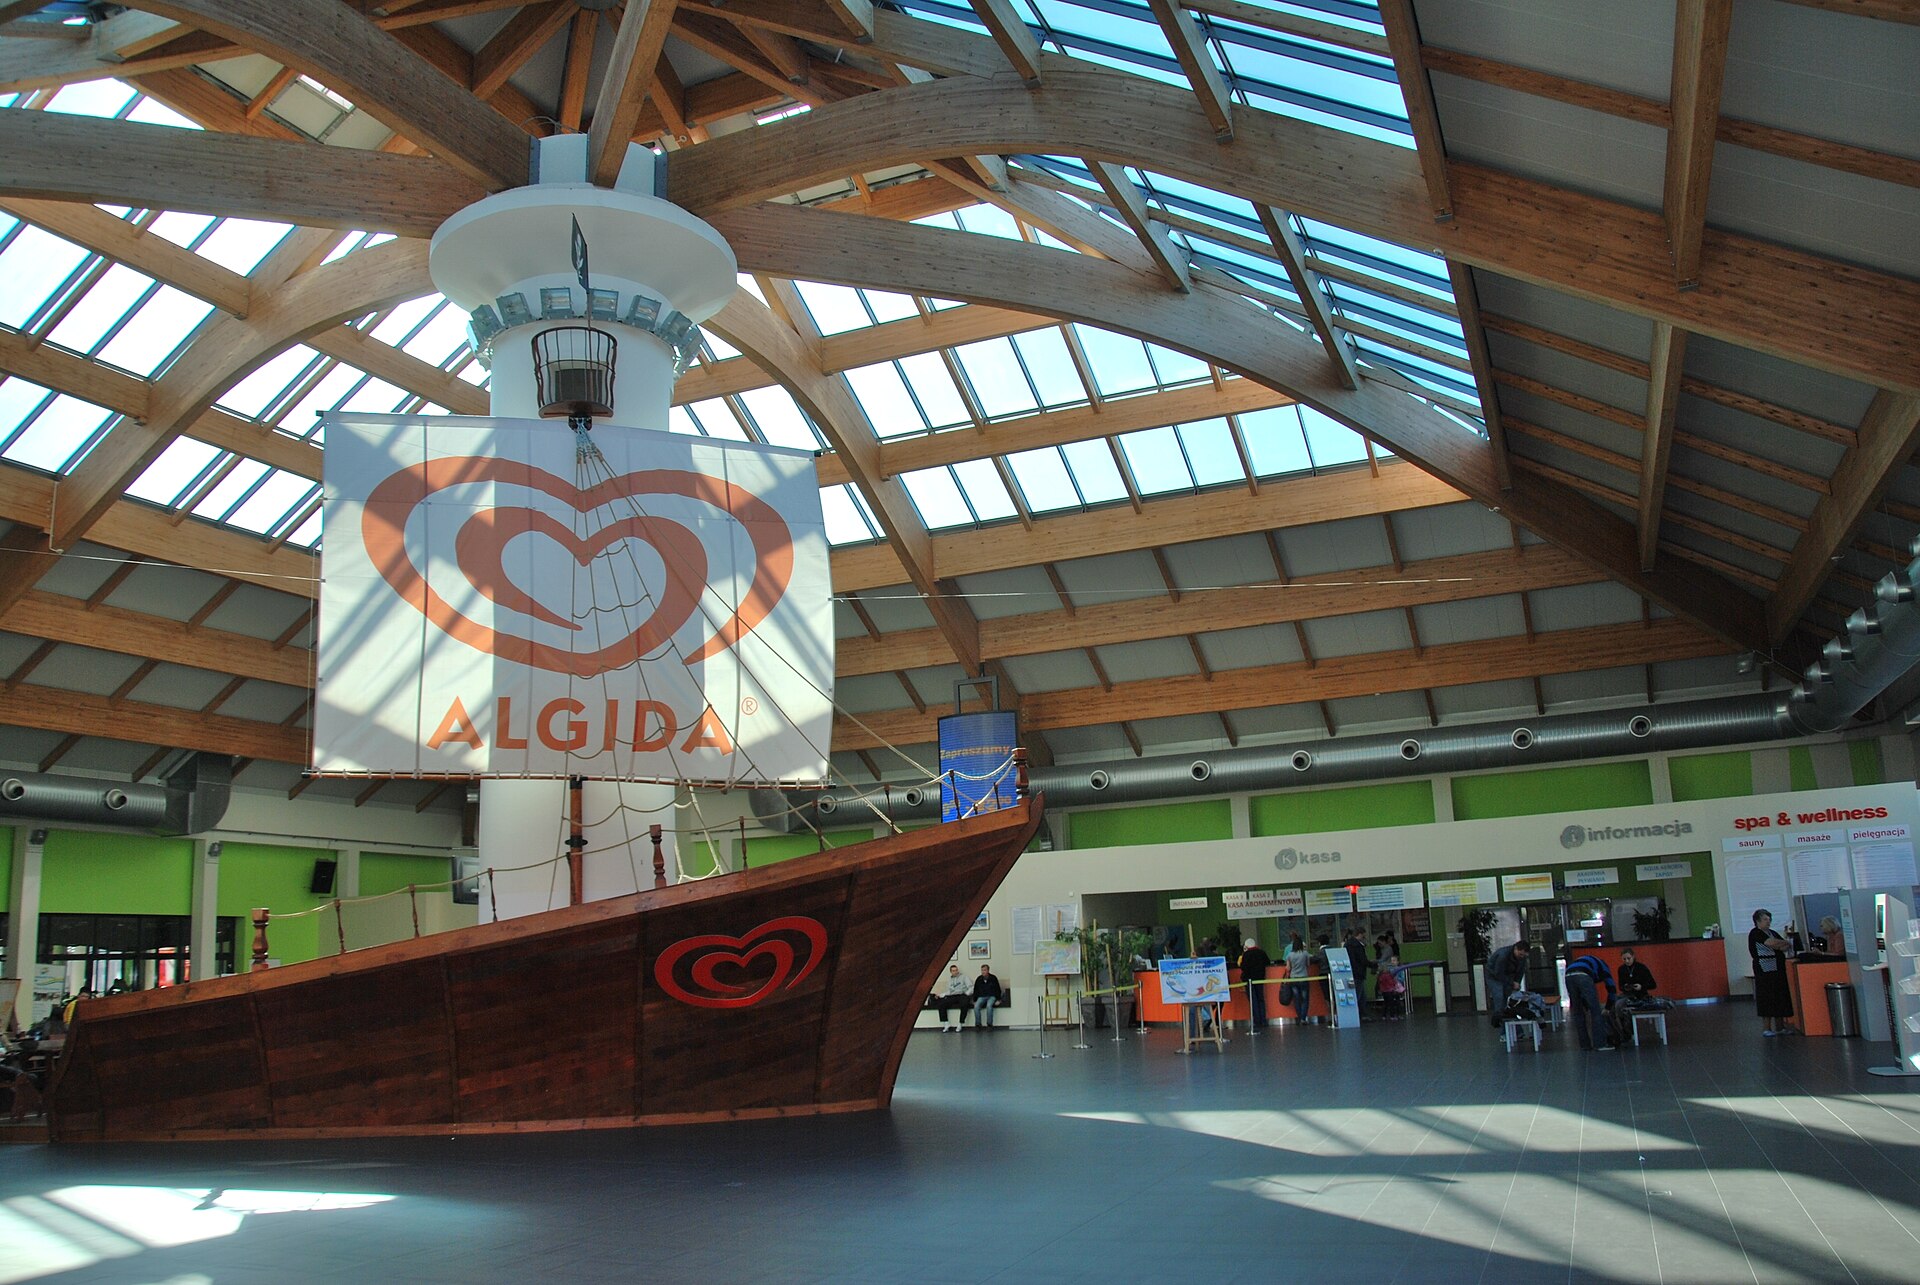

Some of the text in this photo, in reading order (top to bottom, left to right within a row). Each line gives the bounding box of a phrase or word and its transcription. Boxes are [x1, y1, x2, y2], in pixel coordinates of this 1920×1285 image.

[426, 695, 734, 757] ALGIDA
[940, 746, 1010, 759] Zapraszamy
[1734, 806, 1889, 831] spa & wellness
[1588, 819, 1693, 842] informacja
[1853, 827, 1906, 840] pielęgnacja
[1738, 839, 1765, 848] sauny
[1797, 833, 1831, 843] masaże
[1299, 851, 1342, 865] kasa
[1245, 898, 1302, 908] ABONAMENTOWA
